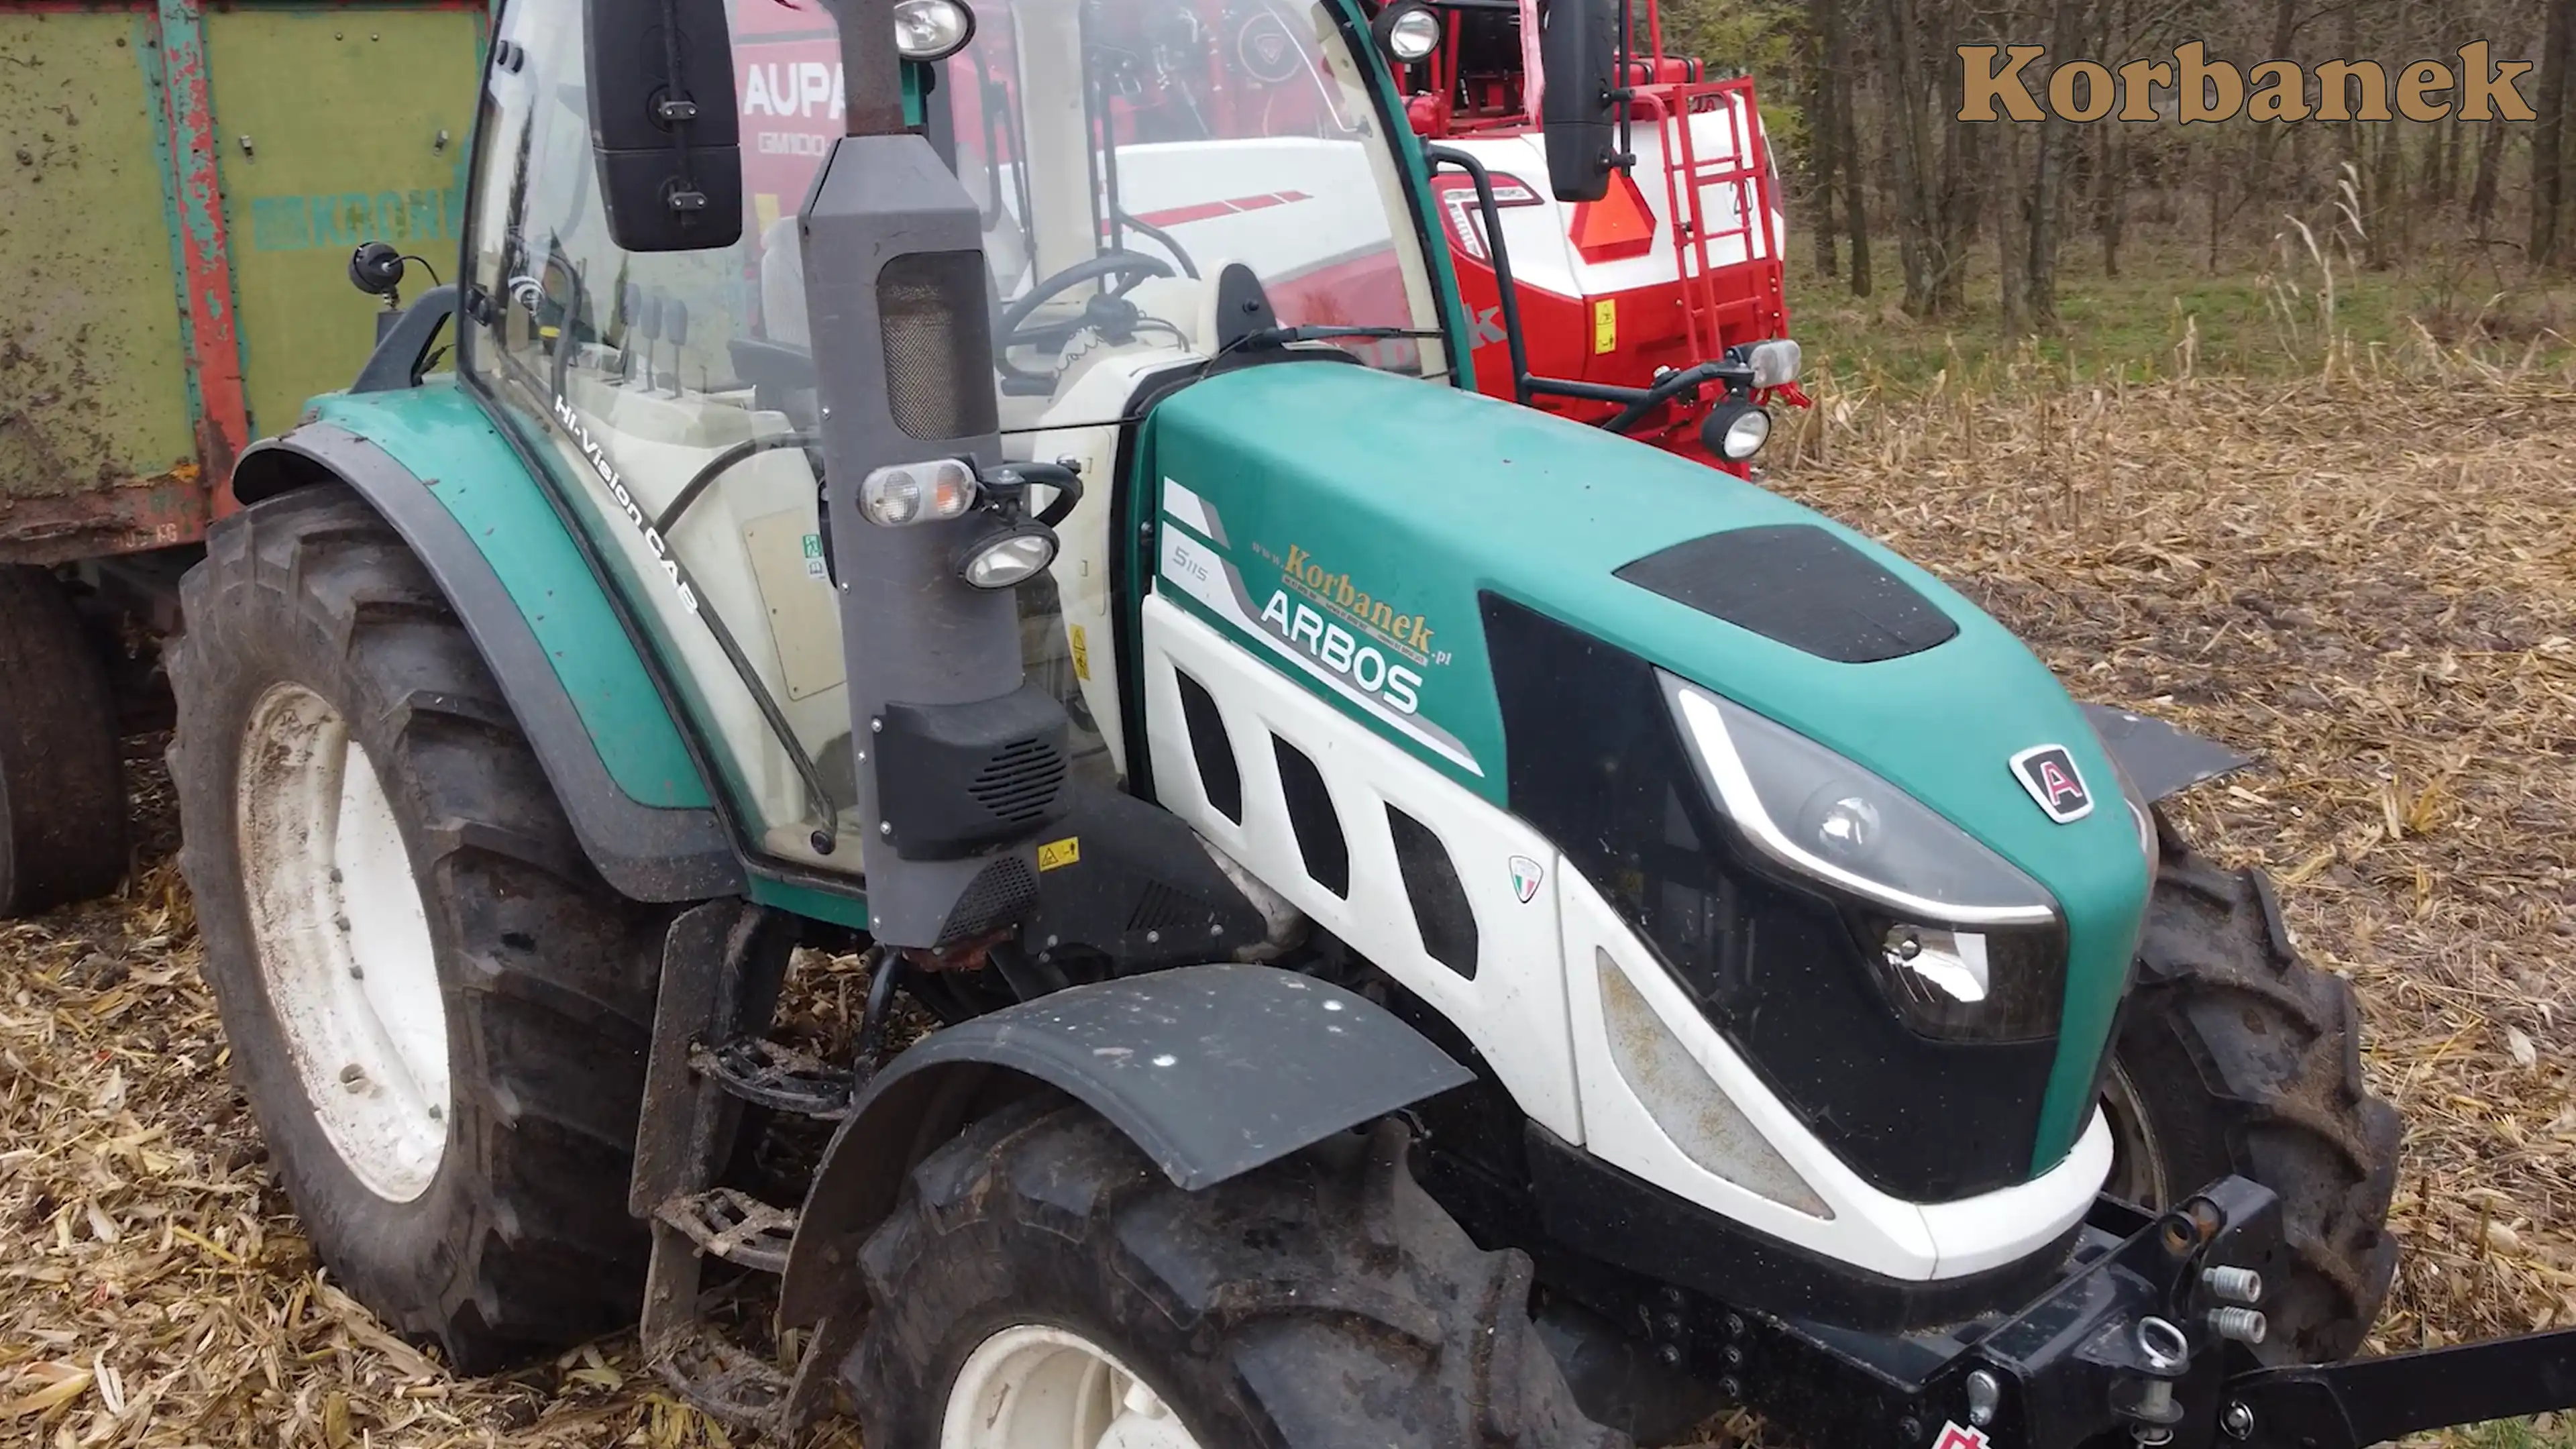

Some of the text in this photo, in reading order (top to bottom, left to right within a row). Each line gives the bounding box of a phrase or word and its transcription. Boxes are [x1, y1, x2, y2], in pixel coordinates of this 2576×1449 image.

[645, 527, 698, 614] CAB
[1172, 545, 1209, 582] 5115
[1260, 589, 1423, 714] ARBOS
[2040, 760, 2084, 806] A
